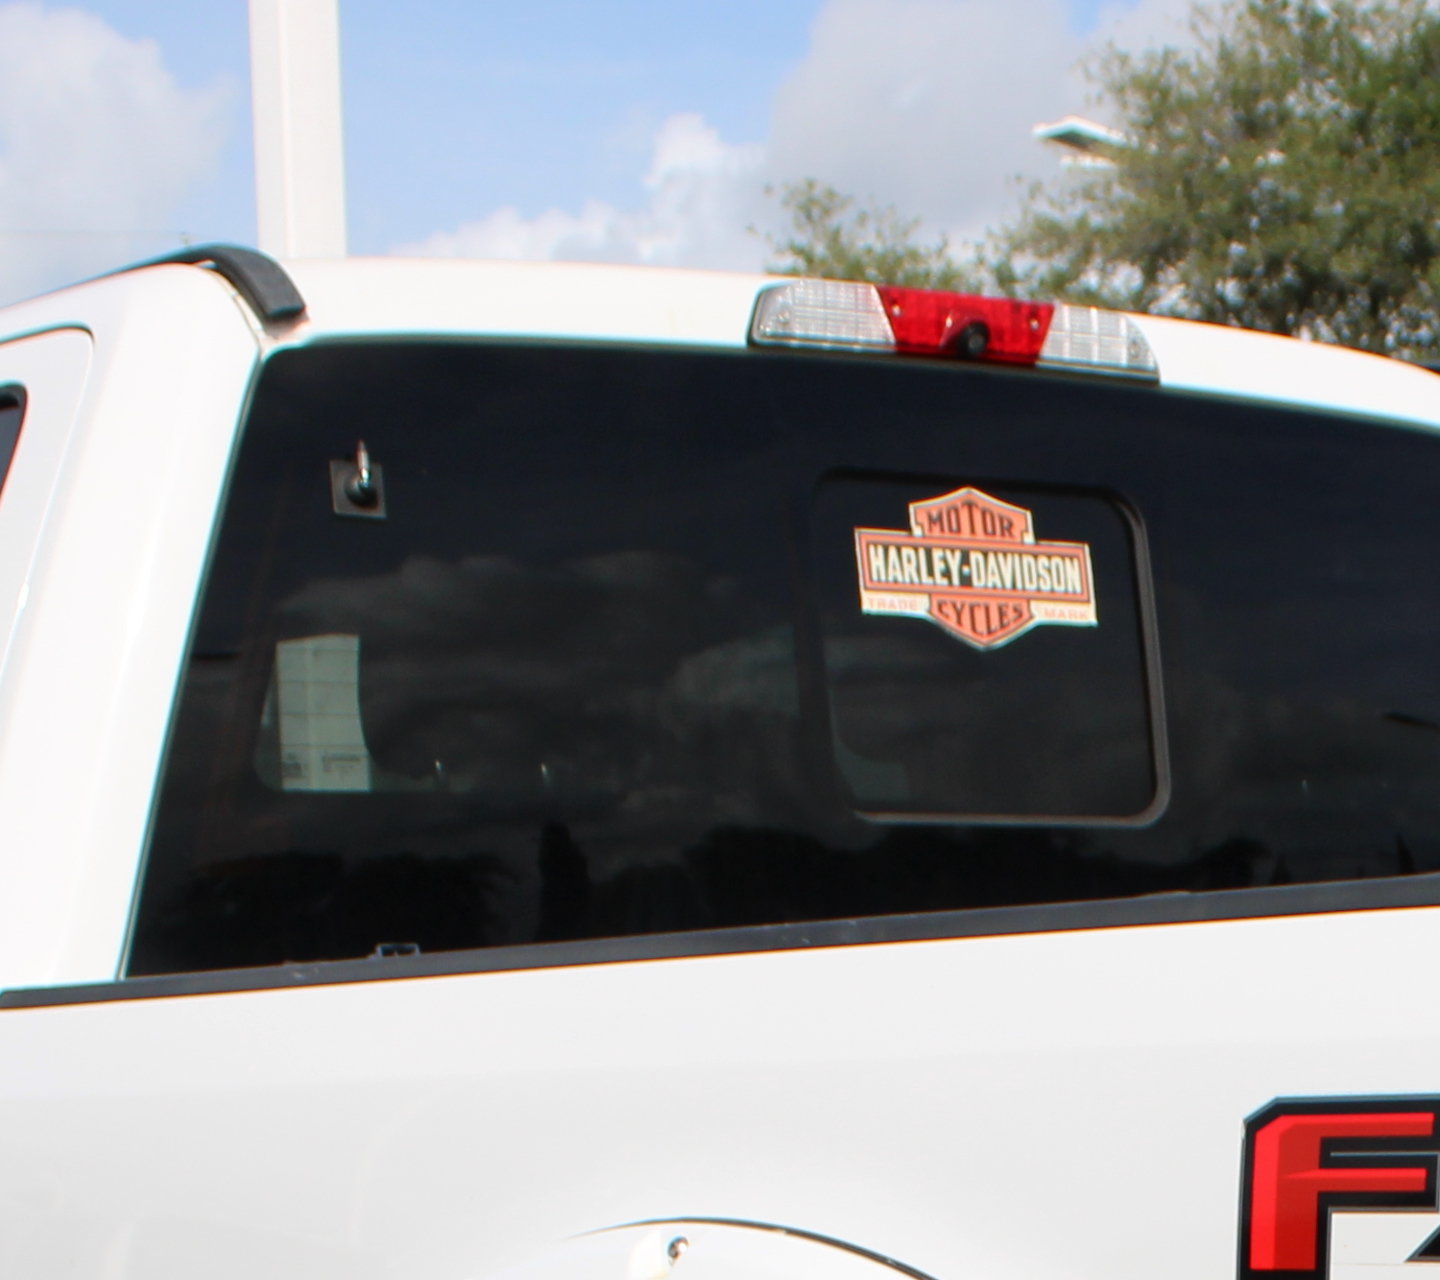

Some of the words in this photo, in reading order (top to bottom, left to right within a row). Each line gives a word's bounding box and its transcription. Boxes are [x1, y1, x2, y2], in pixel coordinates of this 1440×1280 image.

[926, 501, 1015, 538] MOTOR
[868, 543, 1082, 594] HARLEY-DAVIDSON
[936, 600, 1024, 636] CYCLES
